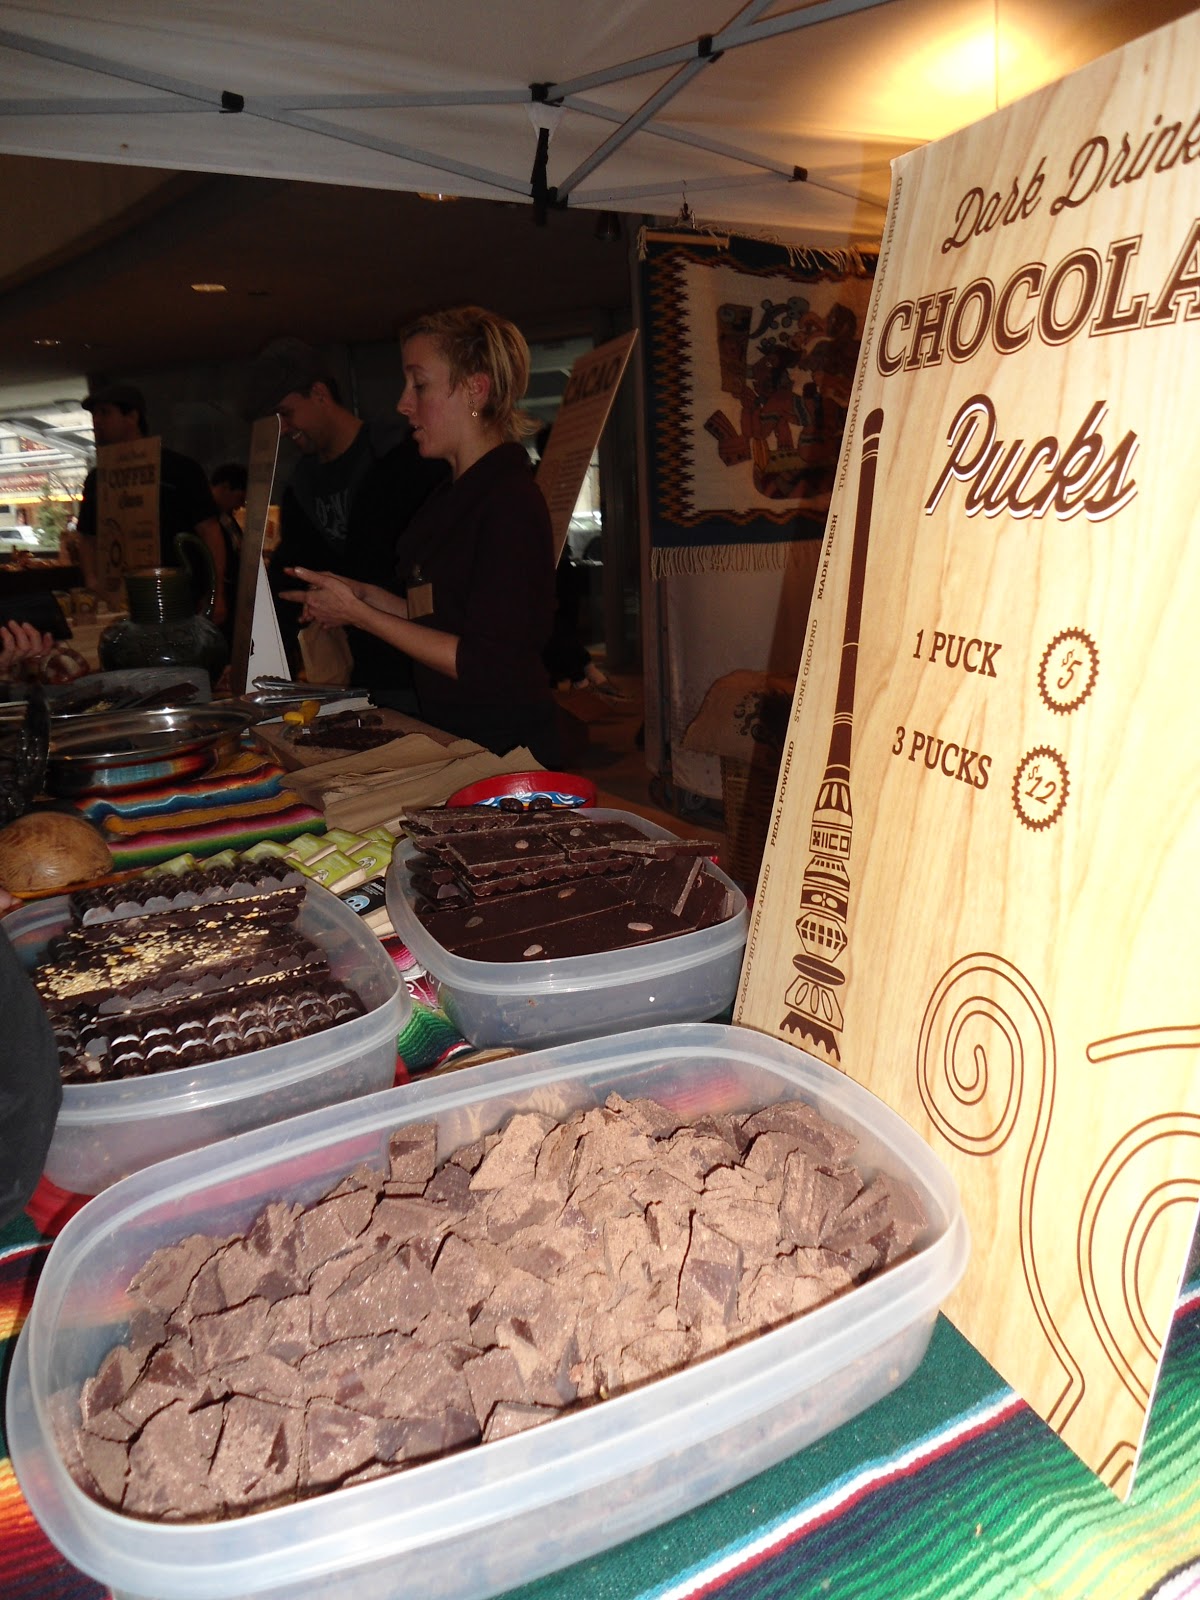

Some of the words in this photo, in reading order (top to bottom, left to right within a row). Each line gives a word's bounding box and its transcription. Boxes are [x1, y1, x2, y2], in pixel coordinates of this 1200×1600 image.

[941, 156, 1048, 254] Dark
[838, 395, 861, 492] TRADITIONAL
[857, 328, 874, 391] MEXICAN
[871, 246, 891, 324] XOCOLATL
[887, 177, 903, 244] INSPIRED
[924, 394, 1138, 523] Pucks
[817, 560, 829, 600] MADE
[825, 514, 838, 557] FRESH
[794, 680, 807, 723] STONE
[803, 619, 818, 677] GROUND
[913, 629, 924, 659] 1
[929, 631, 1002, 678] PUCK
[770, 806, 783, 847] PEDAL
[779, 741, 795, 804] POWERED
[892, 726, 906, 755] 3
[908, 731, 992, 789] PUCKS
[741, 961, 752, 1003] CACAO
[750, 910, 762, 960] BUTTER
[759, 863, 771, 908] ADDED
